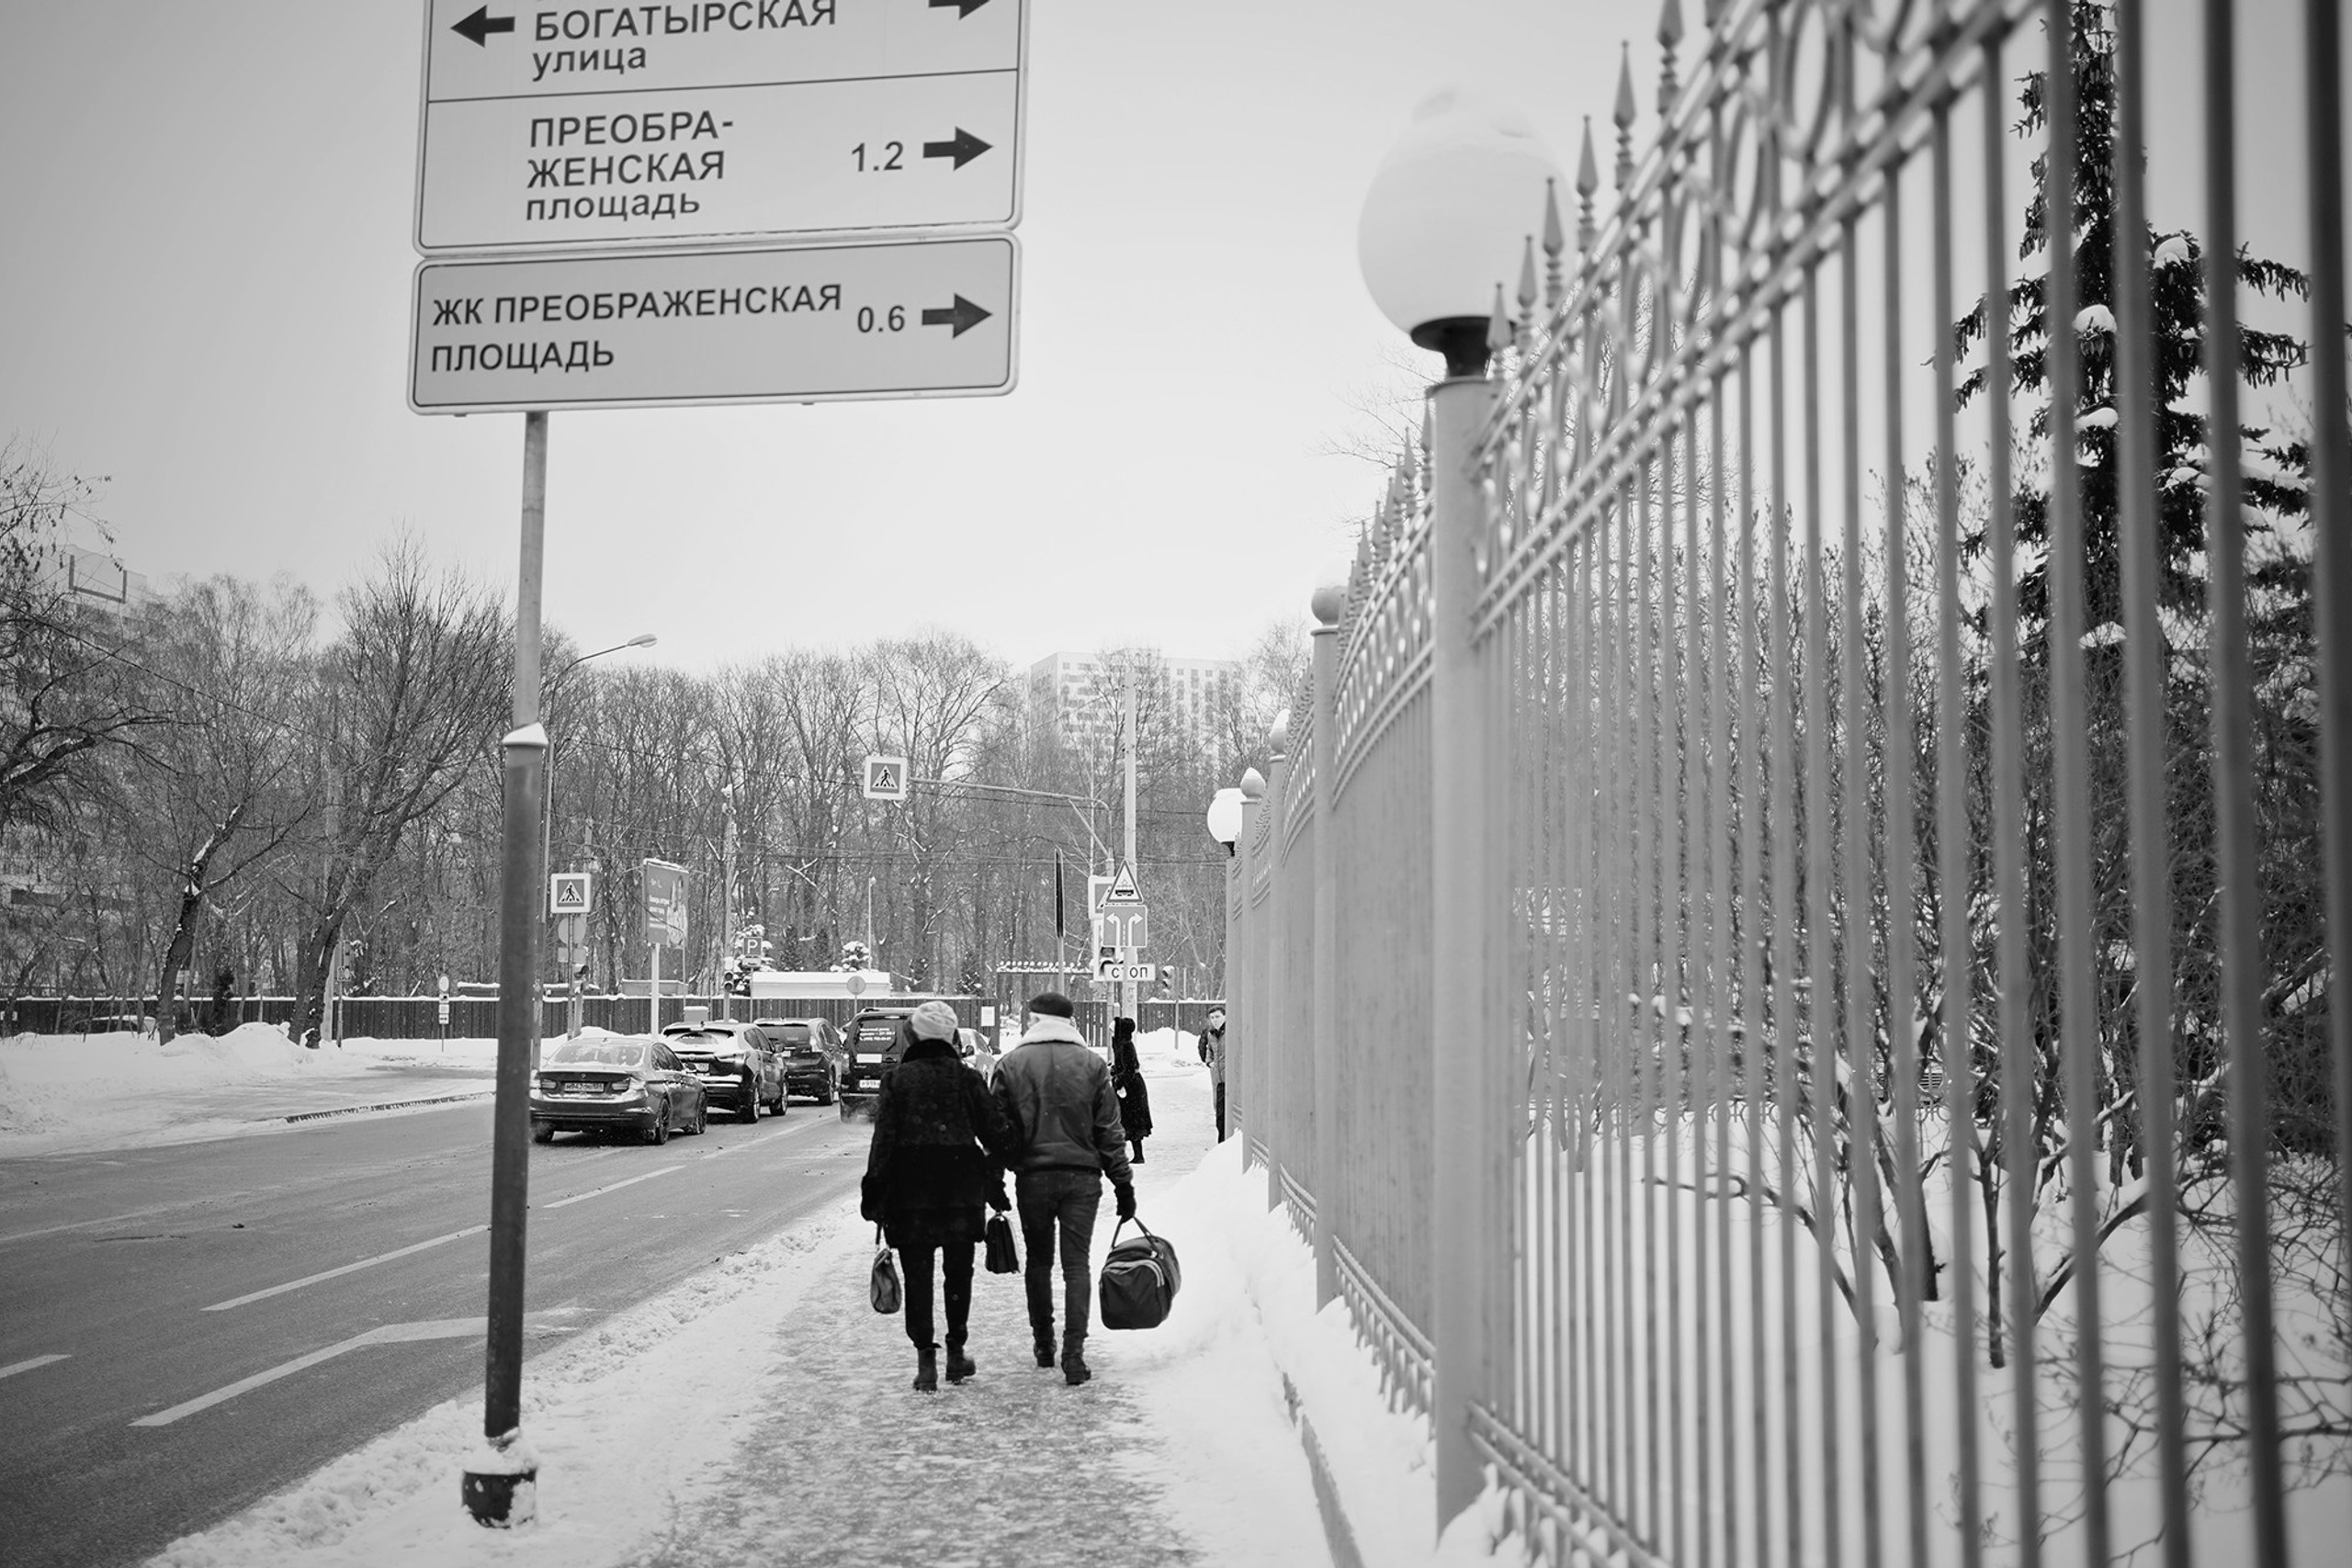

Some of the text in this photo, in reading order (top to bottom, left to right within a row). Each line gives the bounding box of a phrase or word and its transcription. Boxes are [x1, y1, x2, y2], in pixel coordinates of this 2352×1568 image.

[536, 0, 835, 41] БОГАТЫРСКАЯ
[533, 47, 645, 82] улица
[531, 110, 733, 147] ПРЕОБРА-
[527, 152, 723, 188] ЖЕНСКАЯ
[853, 141, 902, 171] 1.2
[527, 192, 700, 220] площадь
[434, 285, 841, 326] ЖК ПРЕОБРАЖЕНСКАЯ
[858, 306, 904, 333] 0.6
[433, 340, 613, 373] ПЛОЩАДЬ
[747, 939, 759, 954] P
[1112, 966, 1148, 979] СОП
